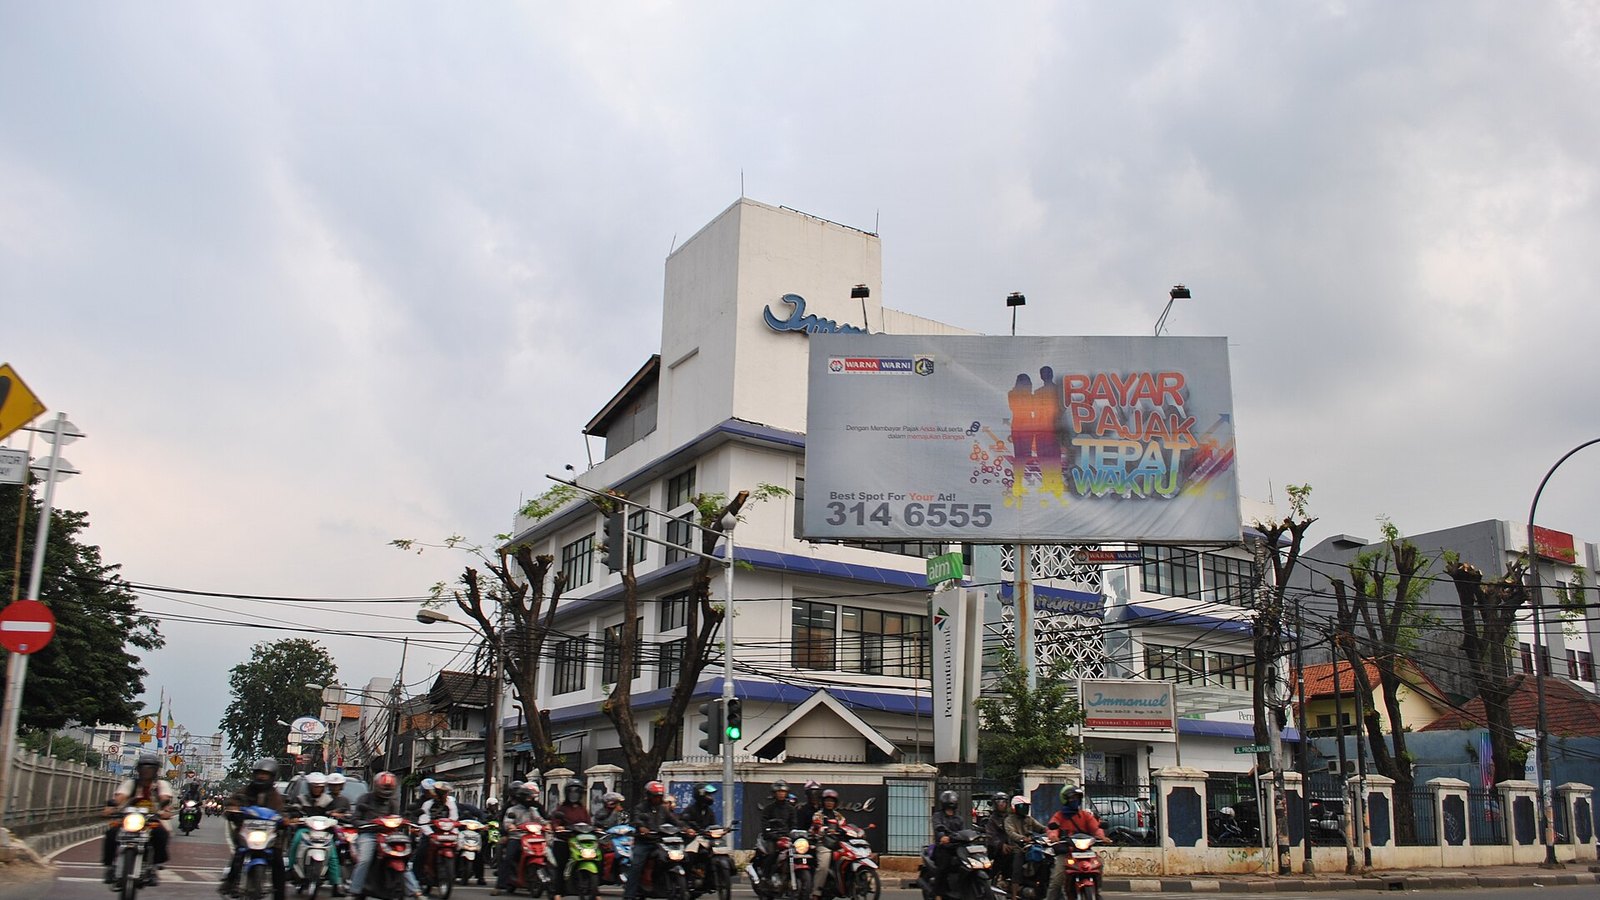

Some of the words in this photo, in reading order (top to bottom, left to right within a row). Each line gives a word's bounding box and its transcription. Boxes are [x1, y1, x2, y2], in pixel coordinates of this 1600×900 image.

[1063, 371, 1185, 408] BAYAR
[903, 425, 919, 433] Pajak
[1071, 402, 1198, 448] PAJAK
[1072, 438, 1192, 474] TEPAT
[1072, 467, 1177, 495] WAKTU
[830, 492, 855, 500] Best
[858, 492, 884, 502] Spot
[888, 492, 906, 500] For
[909, 493, 935, 501] Your
[938, 493, 956, 501] Ad!
[825, 501, 892, 526] 314
[904, 502, 993, 528] 6555
[929, 561, 950, 580] atm
[943, 626, 952, 718] PermataBank
[1088, 692, 1168, 707] Immanuel
